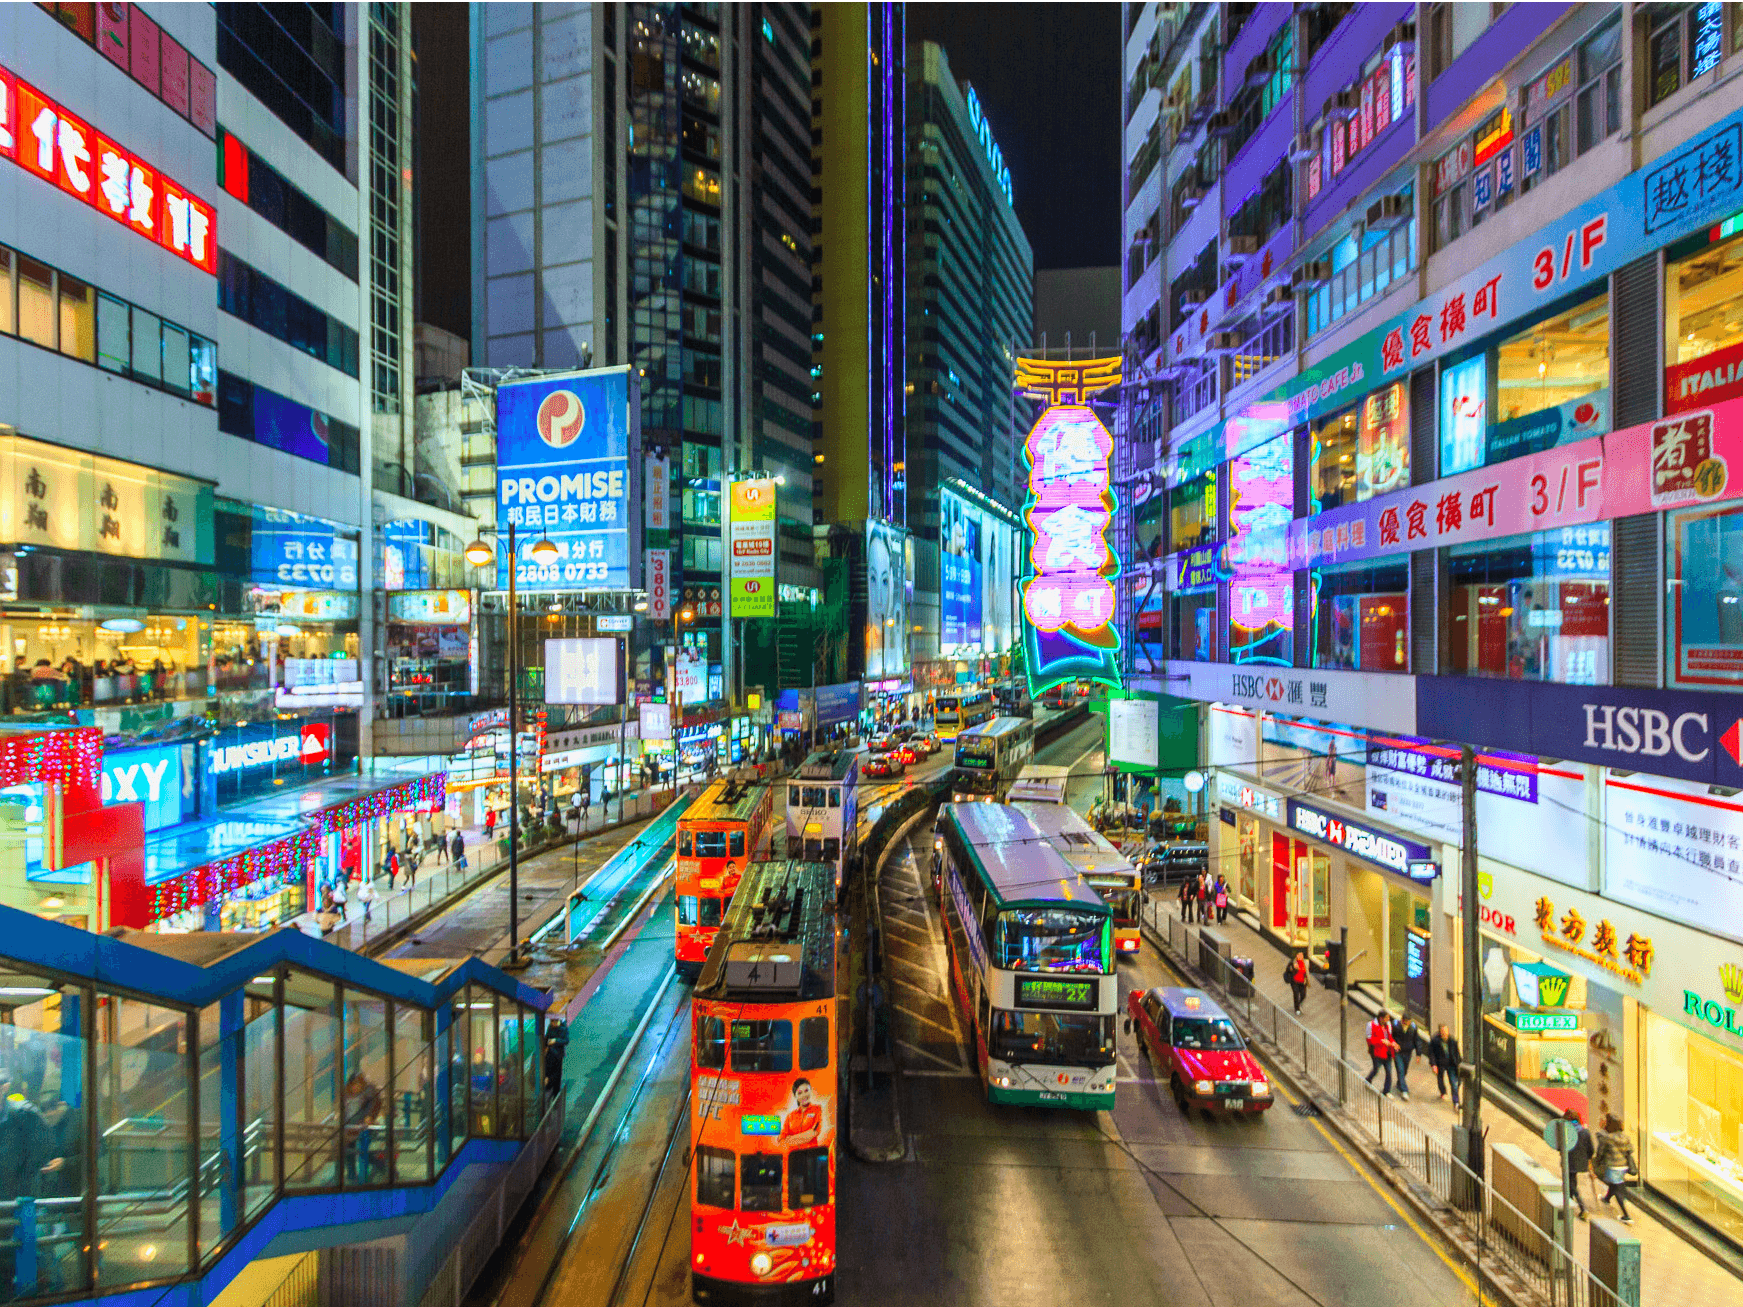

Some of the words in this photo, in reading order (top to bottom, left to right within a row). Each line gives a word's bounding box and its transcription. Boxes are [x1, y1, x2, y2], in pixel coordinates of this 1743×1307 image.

[1533, 214, 1606, 292] 3/F
[1321, 367, 1349, 398] CAFE
[501, 469, 624, 505] PROMISE
[1530, 459, 1602, 516] 3/F
[516, 564, 560, 583] 2808
[564, 562, 608, 580] 0733
[1232, 674, 1265, 699] HSBC
[1582, 703, 1709, 763] HSBC
[1296, 807, 1327, 838] HSBC
[1345, 824, 1409, 873] PREMIER
[747, 963, 778, 983] 41
[1066, 988, 1087, 1002] 2X
[816, 1004, 828, 1015] 41
[1521, 1016, 1572, 1027] ROLEX
[813, 1280, 826, 1295] 41
